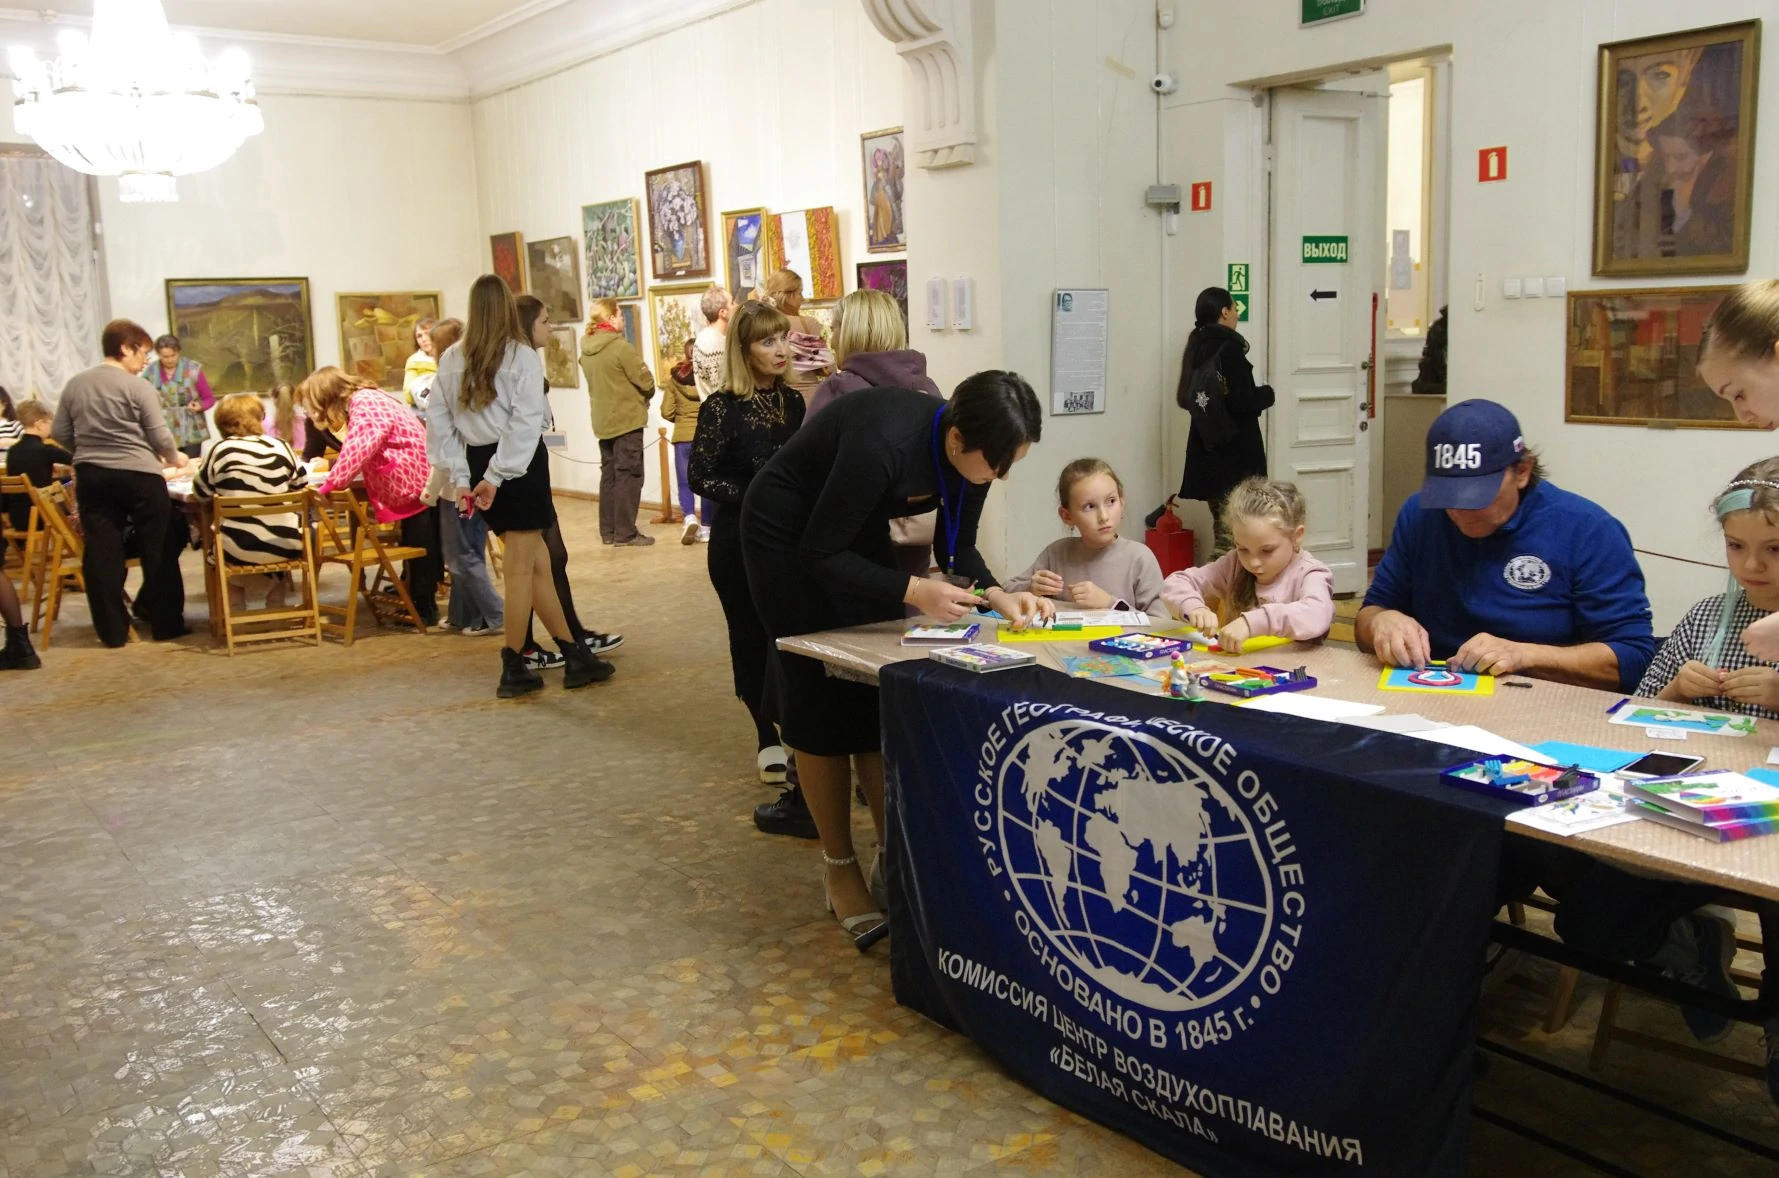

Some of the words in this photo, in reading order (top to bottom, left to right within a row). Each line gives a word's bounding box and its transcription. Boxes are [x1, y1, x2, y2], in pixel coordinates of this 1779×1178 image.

[1304, 243, 1346, 260] ВЫХОД
[1434, 443, 1482, 469] 1845
[974, 723, 1007, 877] РУССКОЕ
[1237, 769, 1306, 995] ОБЩЕСТВО
[1015, 910, 1143, 1040] ОСНОВАНО
[1149, 1018, 1167, 1049] В
[1175, 1010, 1233, 1051] 1845
[938, 948, 1048, 1022] КОМИССИЯ
[1052, 1005, 1108, 1059] ЦЕНТР
[1113, 1047, 1363, 1166] ВОЗДУХОПЛАВАНИЯ
[1050, 1044, 1129, 1102] «БЕЛАЯ
[1131, 1089, 1219, 1144] СКАЛА»
